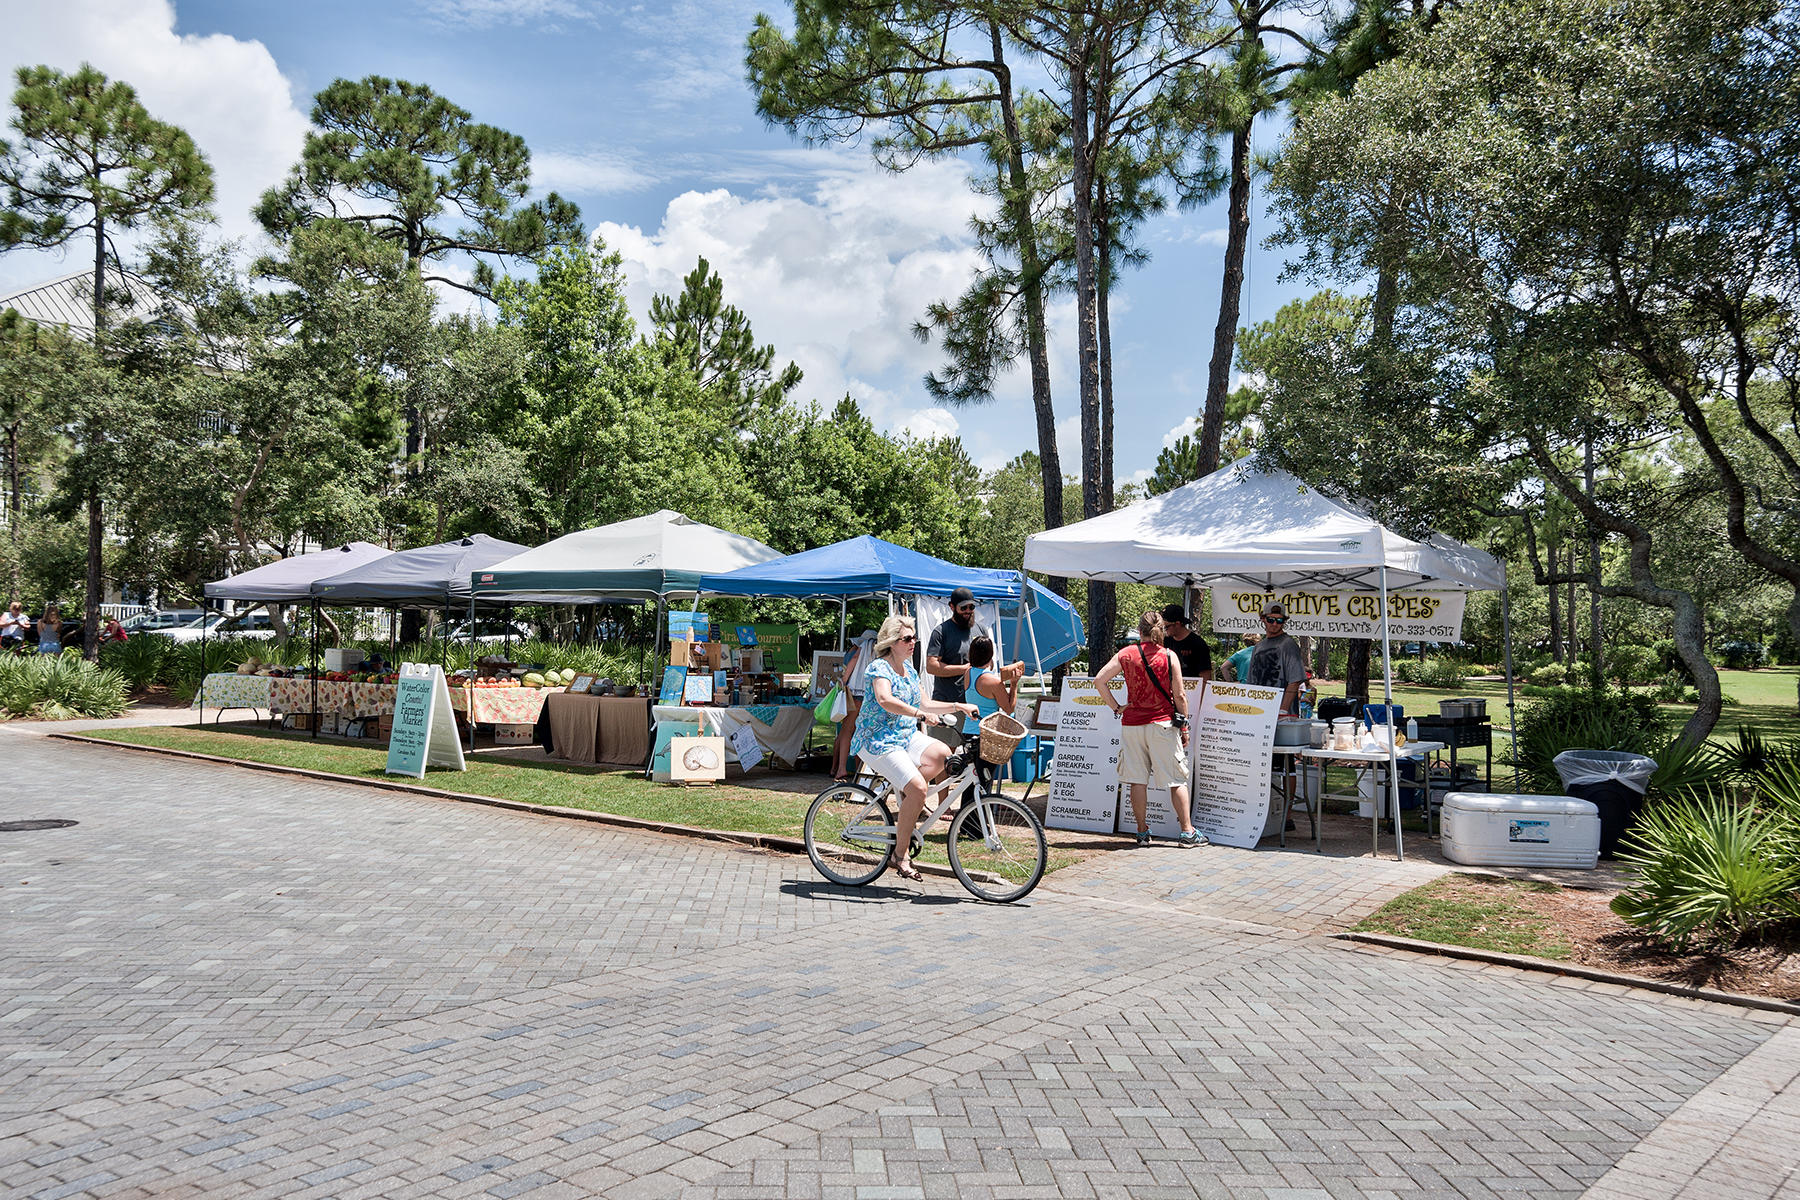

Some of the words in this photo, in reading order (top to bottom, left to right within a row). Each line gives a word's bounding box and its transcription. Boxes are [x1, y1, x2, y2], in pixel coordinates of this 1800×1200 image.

[1284, 620, 1324, 632] SPECIAL
[1328, 621, 1372, 634] EVENTS
[753, 631, 793, 644] ourmet
[401, 682, 431, 694] WaterColor
[400, 703, 427, 717] Farmers'
[1226, 704, 1252, 714] Sweet
[401, 714, 423, 727] Market
[1062, 711, 1097, 719] AMERICAN
[1061, 718, 1090, 726] CLASSIC
[1059, 736, 1083, 744] B.E.S.T.
[1110, 738, 1120, 746] $8
[1057, 753, 1085, 762] GARDEN
[1108, 756, 1118, 764] $8
[1056, 761, 1094, 770] BREAKFAST
[1054, 780, 1076, 789] STEAK
[1105, 784, 1115, 793] $8
[1060, 789, 1075, 798] EGG
[1051, 806, 1092, 816] SCRAMBLER
[1102, 810, 1112, 818] $8
